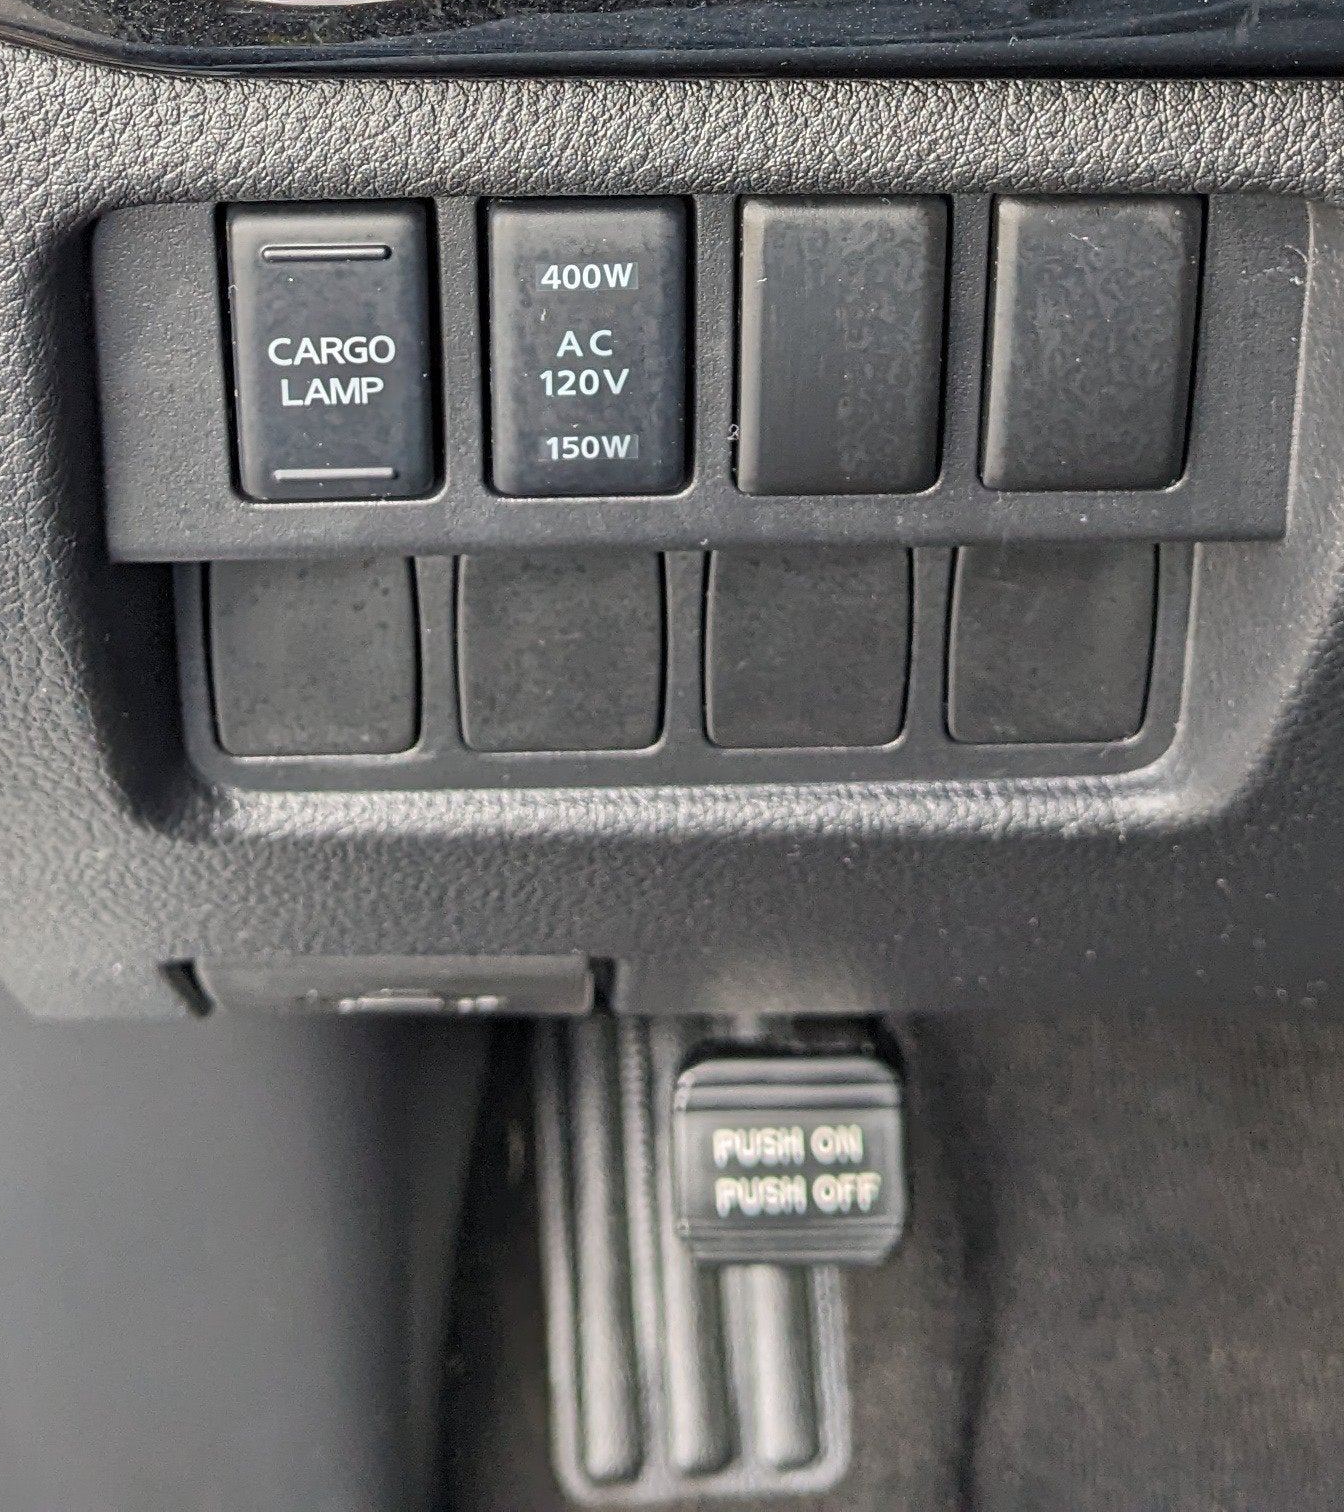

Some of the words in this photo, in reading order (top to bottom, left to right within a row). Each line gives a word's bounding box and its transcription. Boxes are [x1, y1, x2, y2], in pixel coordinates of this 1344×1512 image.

[540, 262, 634, 290] 400W
[267, 334, 396, 367] CARGO
[280, 376, 384, 407] LAMP
[539, 368, 630, 398] 120V
[545, 434, 631, 461] 150W
[712, 1126, 805, 1169] PUSH
[810, 1124, 864, 1165] ON
[714, 1175, 807, 1218] PUSH
[812, 1172, 882, 1214] OFF
